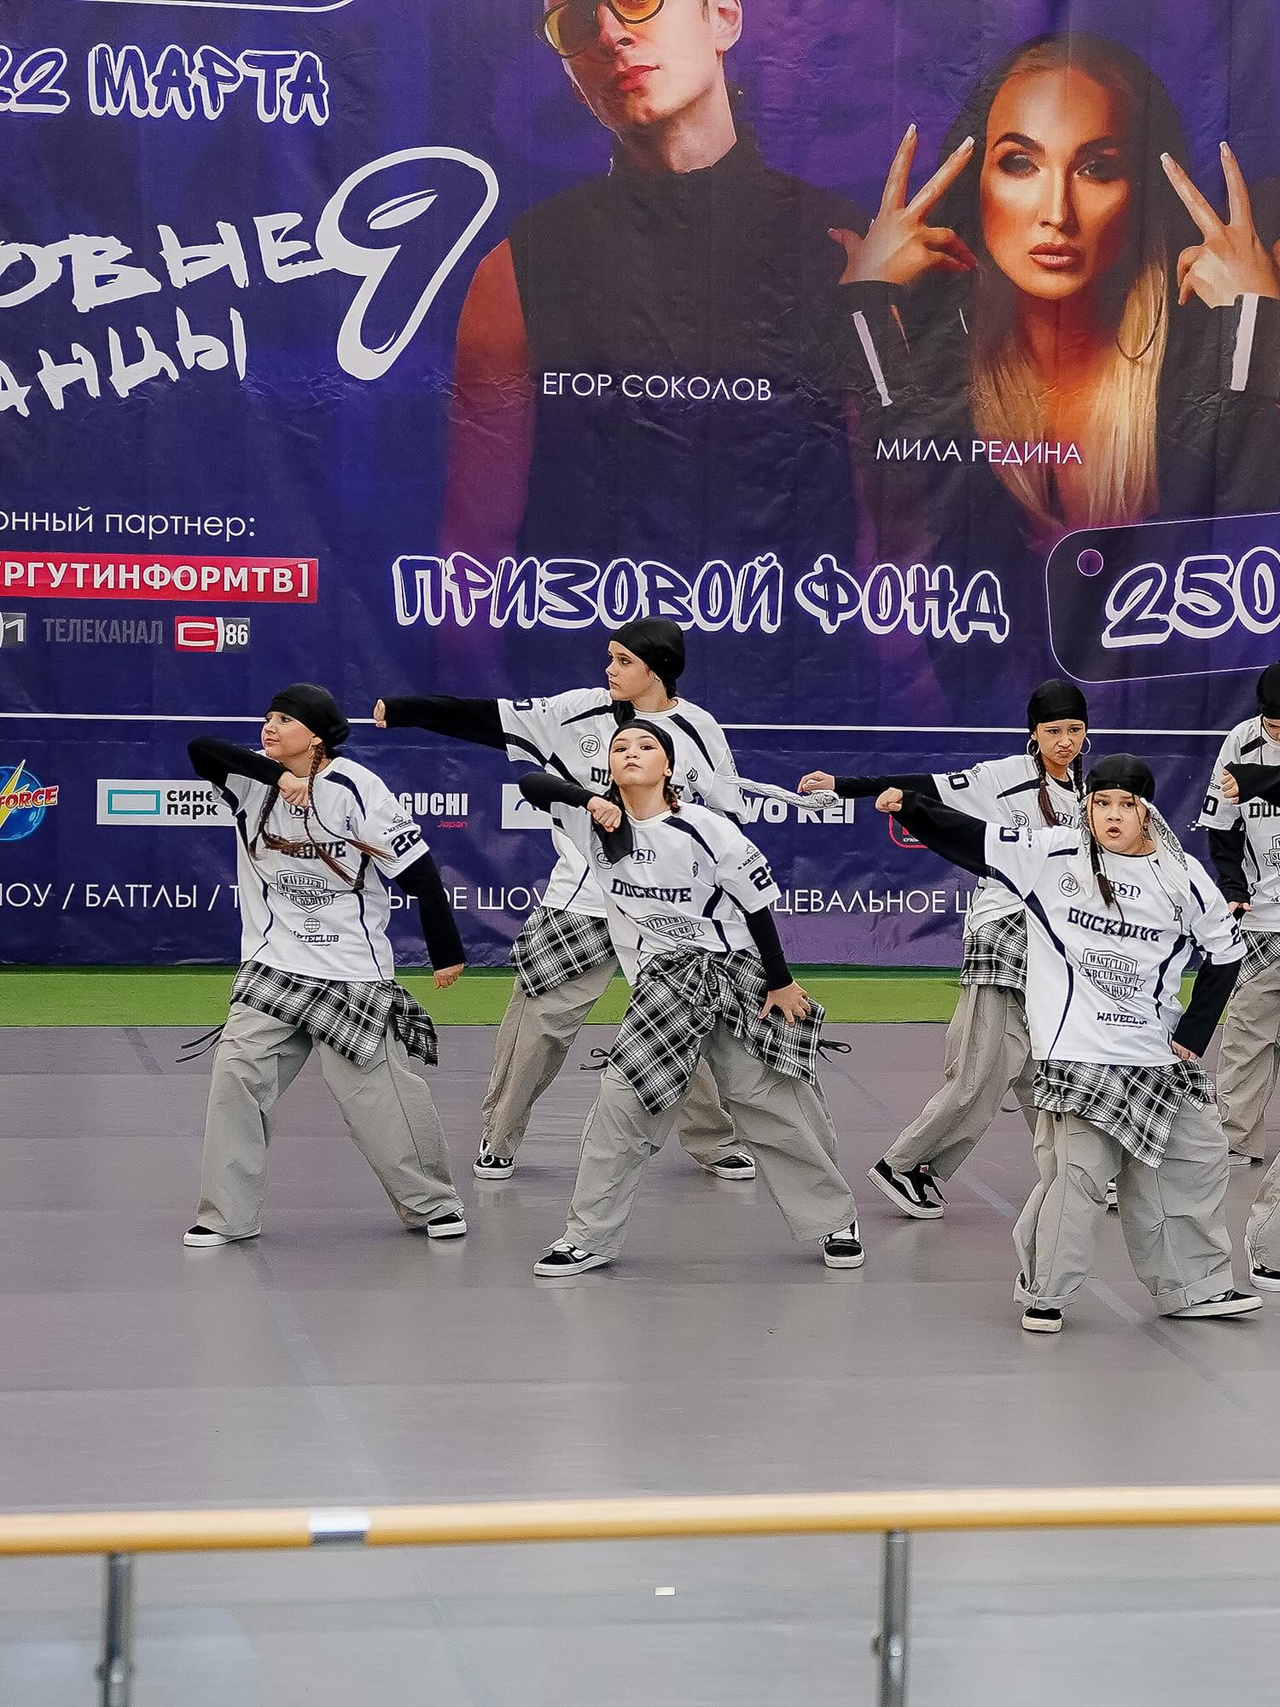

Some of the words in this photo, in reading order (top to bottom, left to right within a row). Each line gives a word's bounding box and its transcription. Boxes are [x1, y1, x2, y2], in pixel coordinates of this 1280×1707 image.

[0, 46, 70, 114] 2
[88, 43, 329, 126] МАРТА
[543, 373, 612, 396] ЕГОР
[622, 375, 771, 401] СОКОЛОВ
[876, 438, 962, 462] МИЛА
[971, 440, 1083, 466] РЕДИНА
[105, 512, 256, 543] партнер:
[0, 560, 308, 599] РГУТИНФОРМТВ]
[391, 551, 783, 633] ПРИЗОВОЙ
[795, 555, 1010, 643] ФОНД
[43, 618, 163, 646] ТЕЛЕКАНАЛ
[166, 804, 219, 819] парк
[398, 793, 468, 816] GUCHI
[0, 883, 52, 907] ОУ
[86, 884, 197, 908] БАТТЛЫ
[478, 886, 543, 910] ШОУ
[769, 890, 946, 915] ЦЕВАЛЬНОЕ
[1067, 907, 1166, 943] DUCKDIVE
